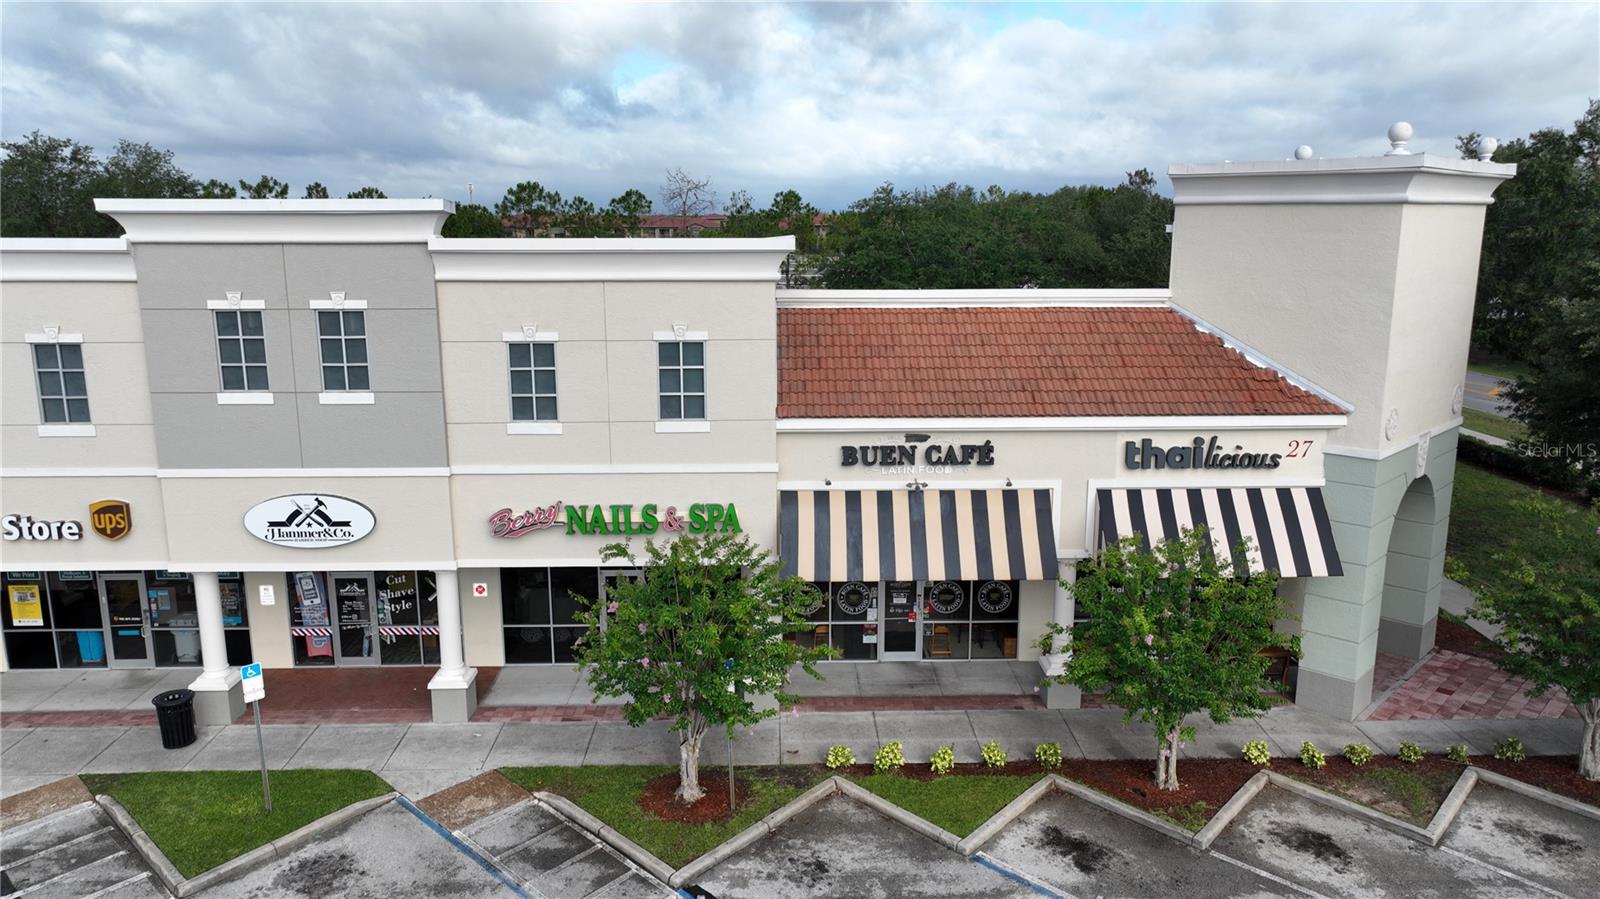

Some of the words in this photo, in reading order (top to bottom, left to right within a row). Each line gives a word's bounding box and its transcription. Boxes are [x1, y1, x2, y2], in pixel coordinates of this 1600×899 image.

[841, 445, 918, 466] BUEN
[924, 439, 995, 466] CAFÉ
[1285, 440, 1314, 459] 27
[881, 466, 915, 475] LATIN
[918, 465, 952, 474] FOOD
[94, 512, 125, 535] ups
[564, 504, 659, 536] NAILS
[663, 505, 685, 532] &
[688, 502, 743, 535] SPA
[1, 514, 83, 541] Store
[264, 528, 355, 540] Hammer&Co.
[386, 574, 407, 585] Cut
[380, 587, 415, 599] Shave
[384, 600, 413, 614] Style
